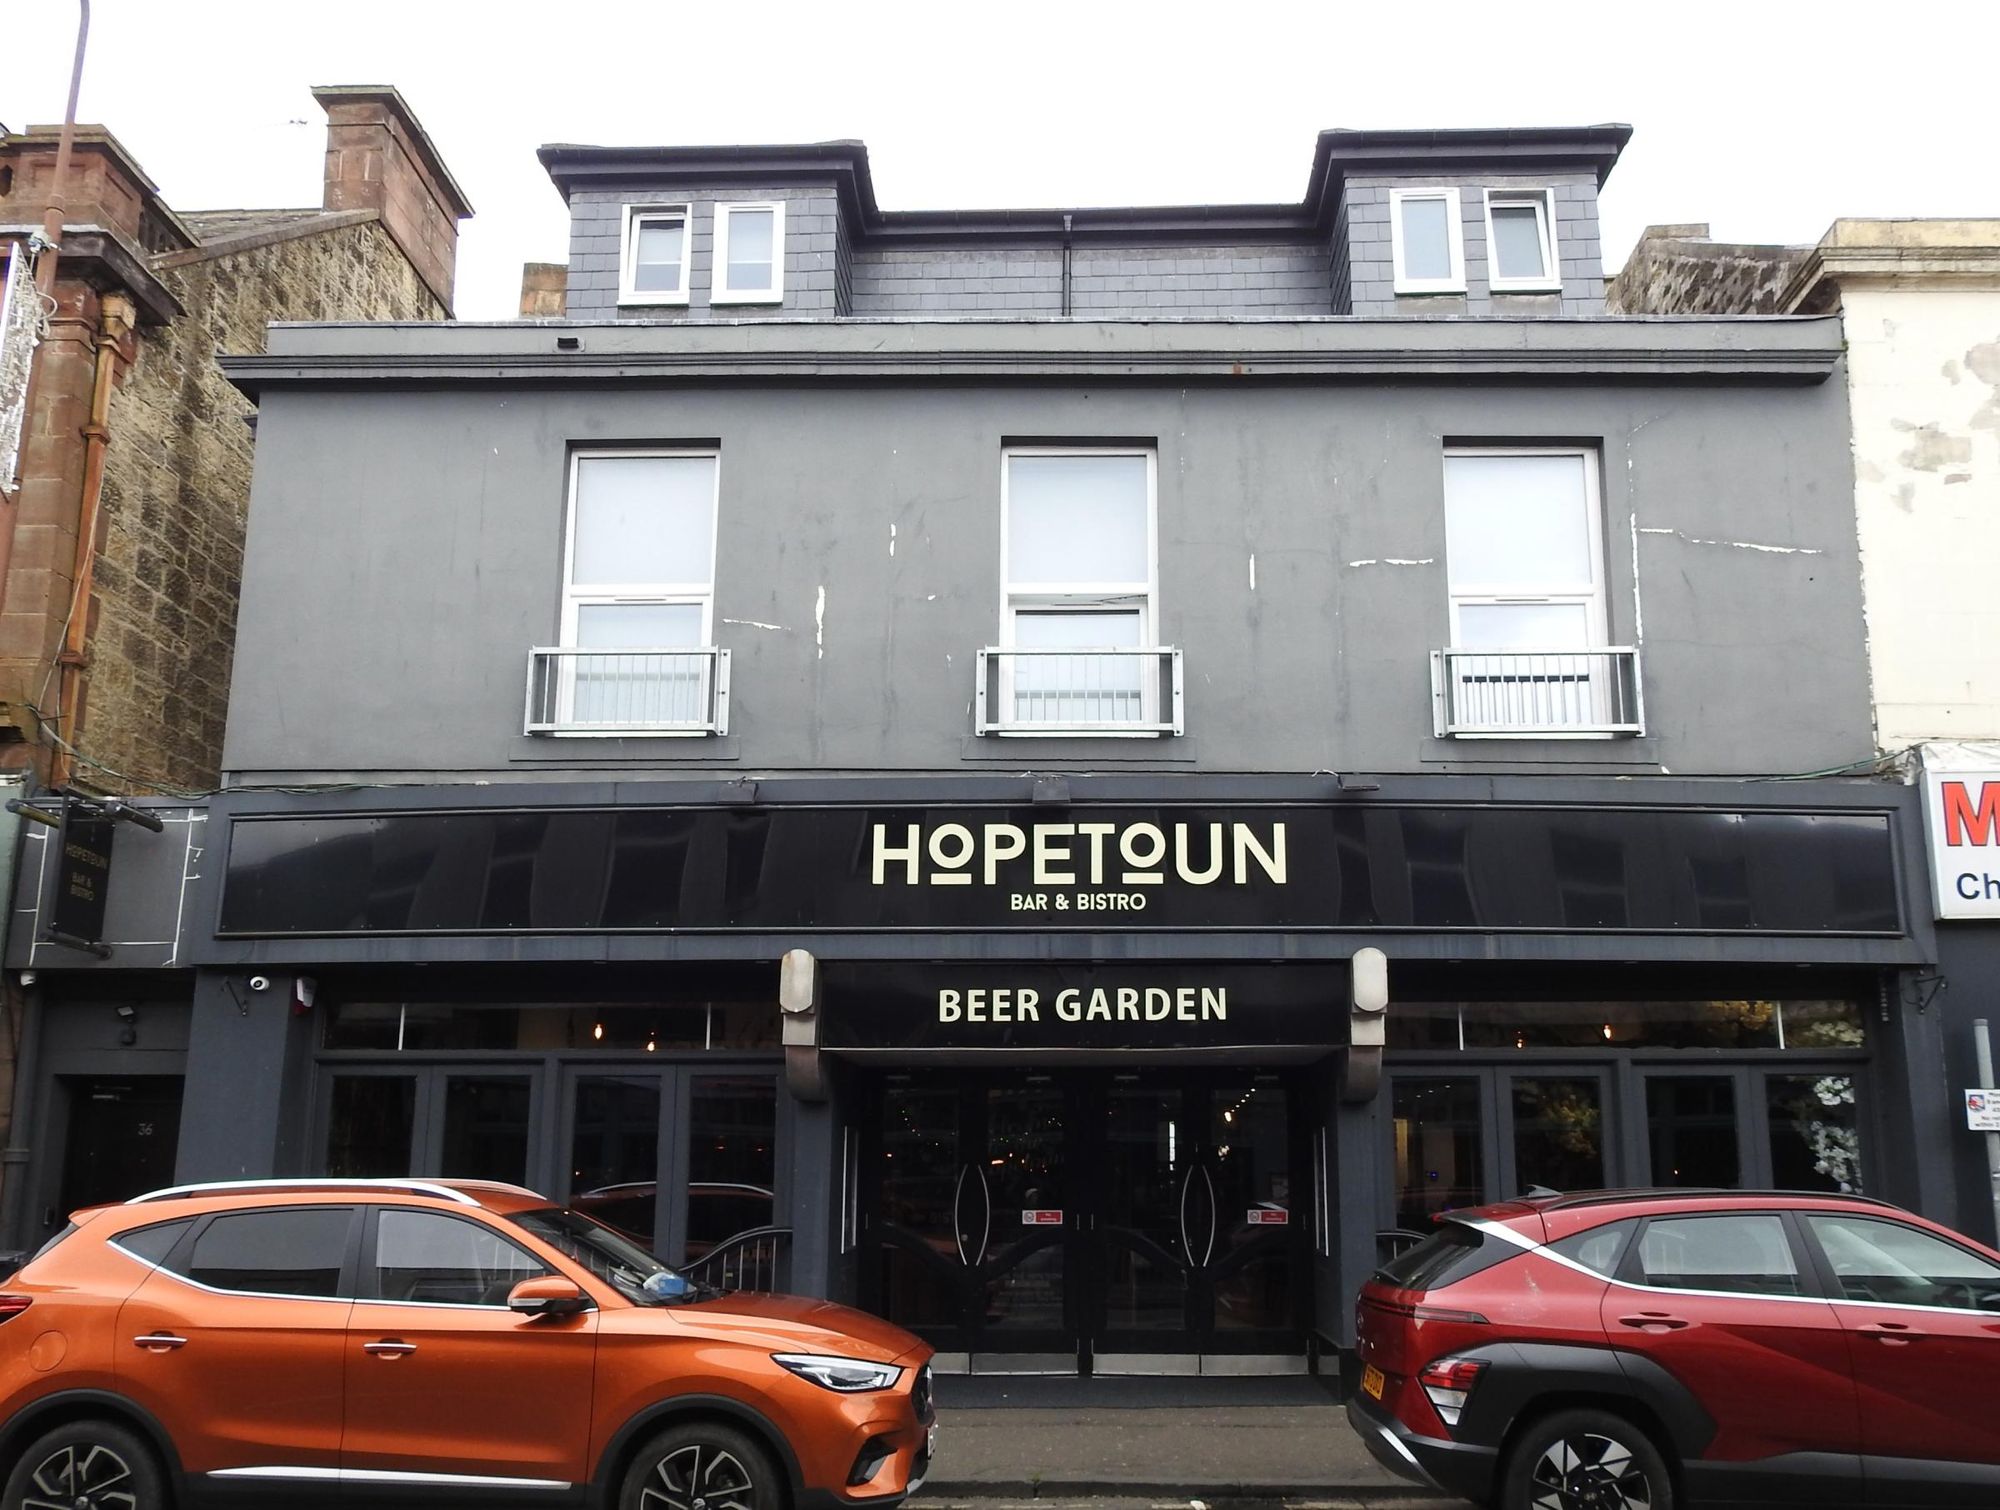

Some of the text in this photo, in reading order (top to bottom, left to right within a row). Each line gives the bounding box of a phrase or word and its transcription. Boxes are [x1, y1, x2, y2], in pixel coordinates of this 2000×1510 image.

[872, 822, 1287, 884] HOPETOUN
[1010, 893, 1147, 911] BAR & BISTRO
[939, 987, 1227, 1022] BEER GARDEN
[137, 1122, 153, 1136] 36
